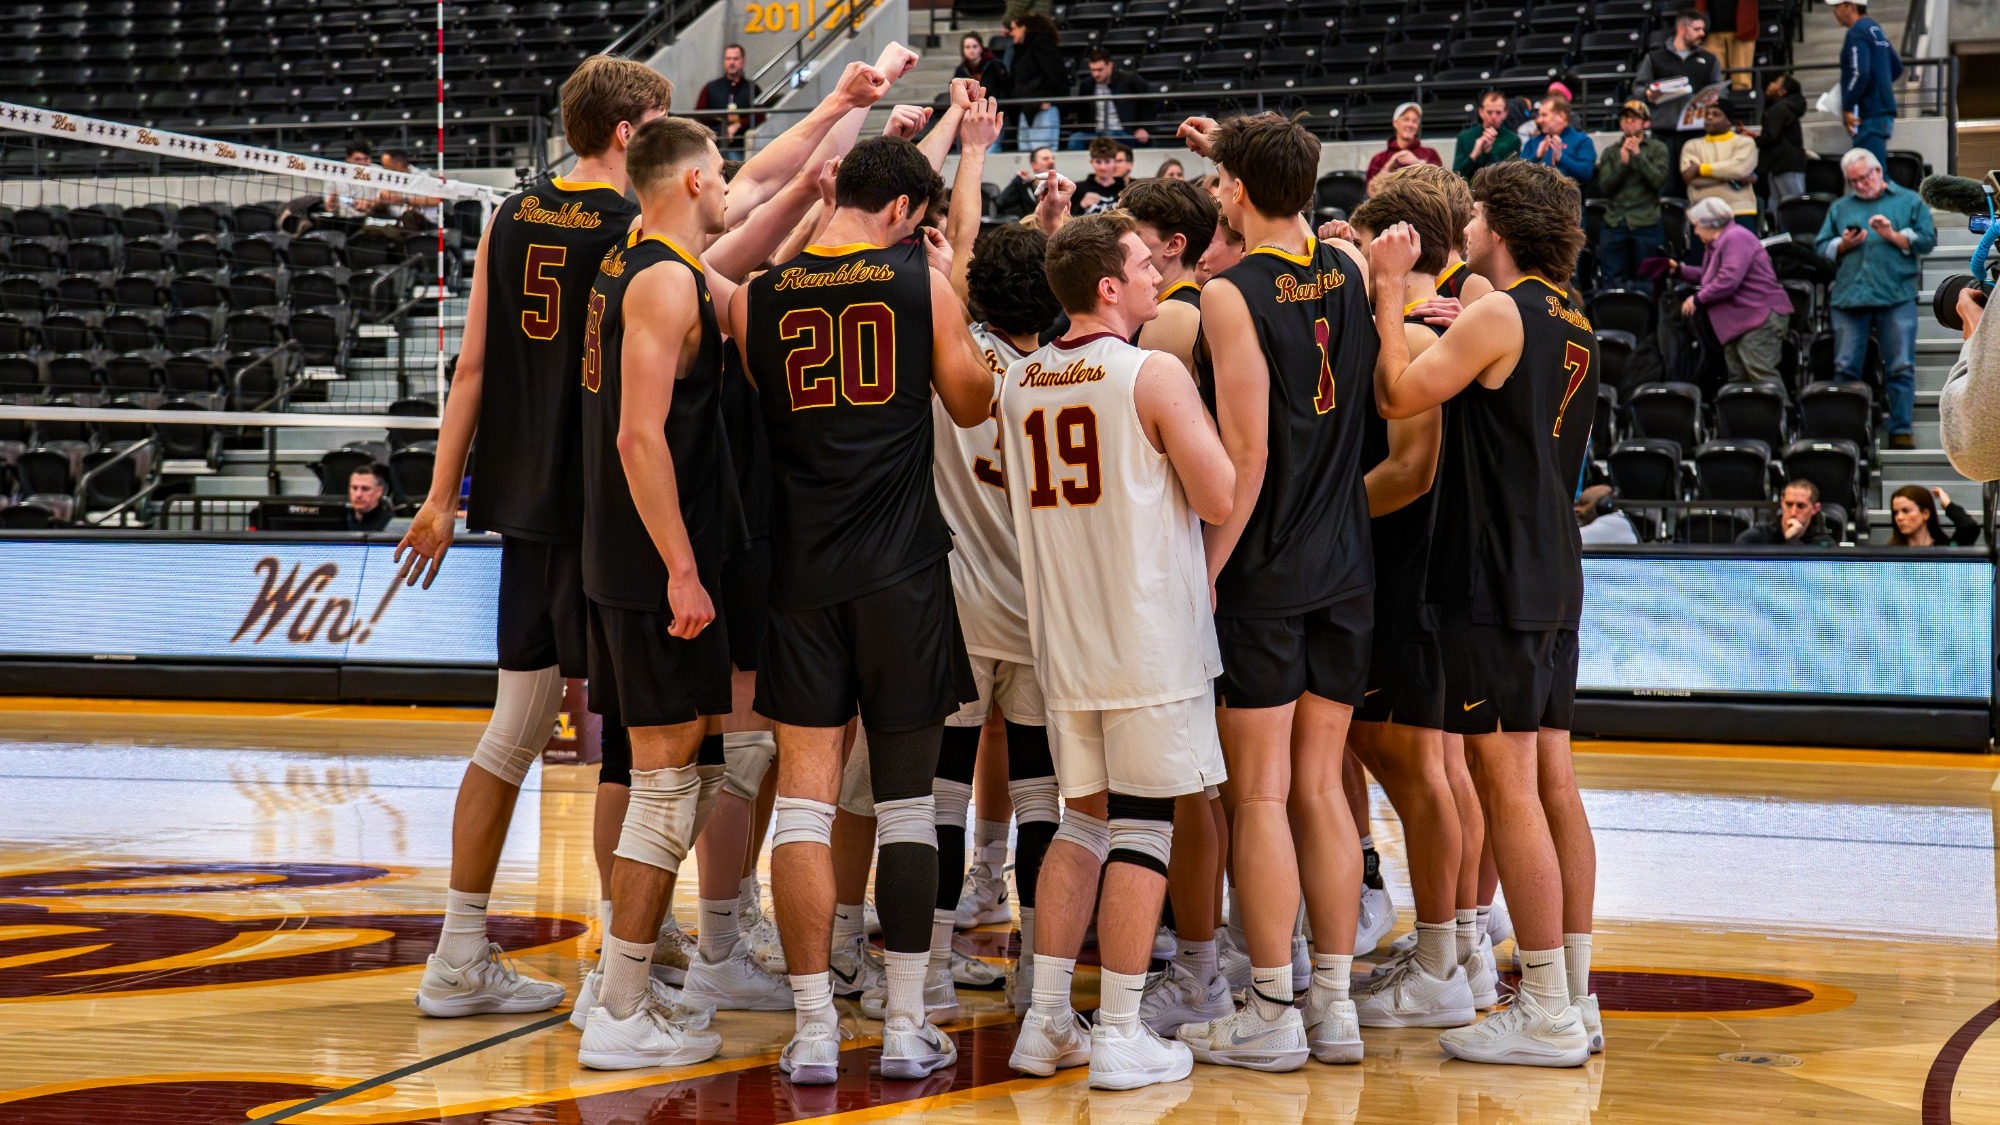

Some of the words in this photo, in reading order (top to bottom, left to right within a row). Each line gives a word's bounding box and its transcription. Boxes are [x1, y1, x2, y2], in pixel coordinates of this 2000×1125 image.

[743, 2, 801, 33] 201
[513, 196, 601, 229] Ramblers
[522, 243, 567, 340] 5
[775, 259, 895, 292] Ramblers
[779, 302, 896, 412] 20
[1019, 358, 1106, 388] Ramblers
[1313, 317, 1336, 415] 1
[1552, 340, 1590, 438] 7
[1023, 404, 1103, 510] 19
[229, 556, 406, 645] Win!
